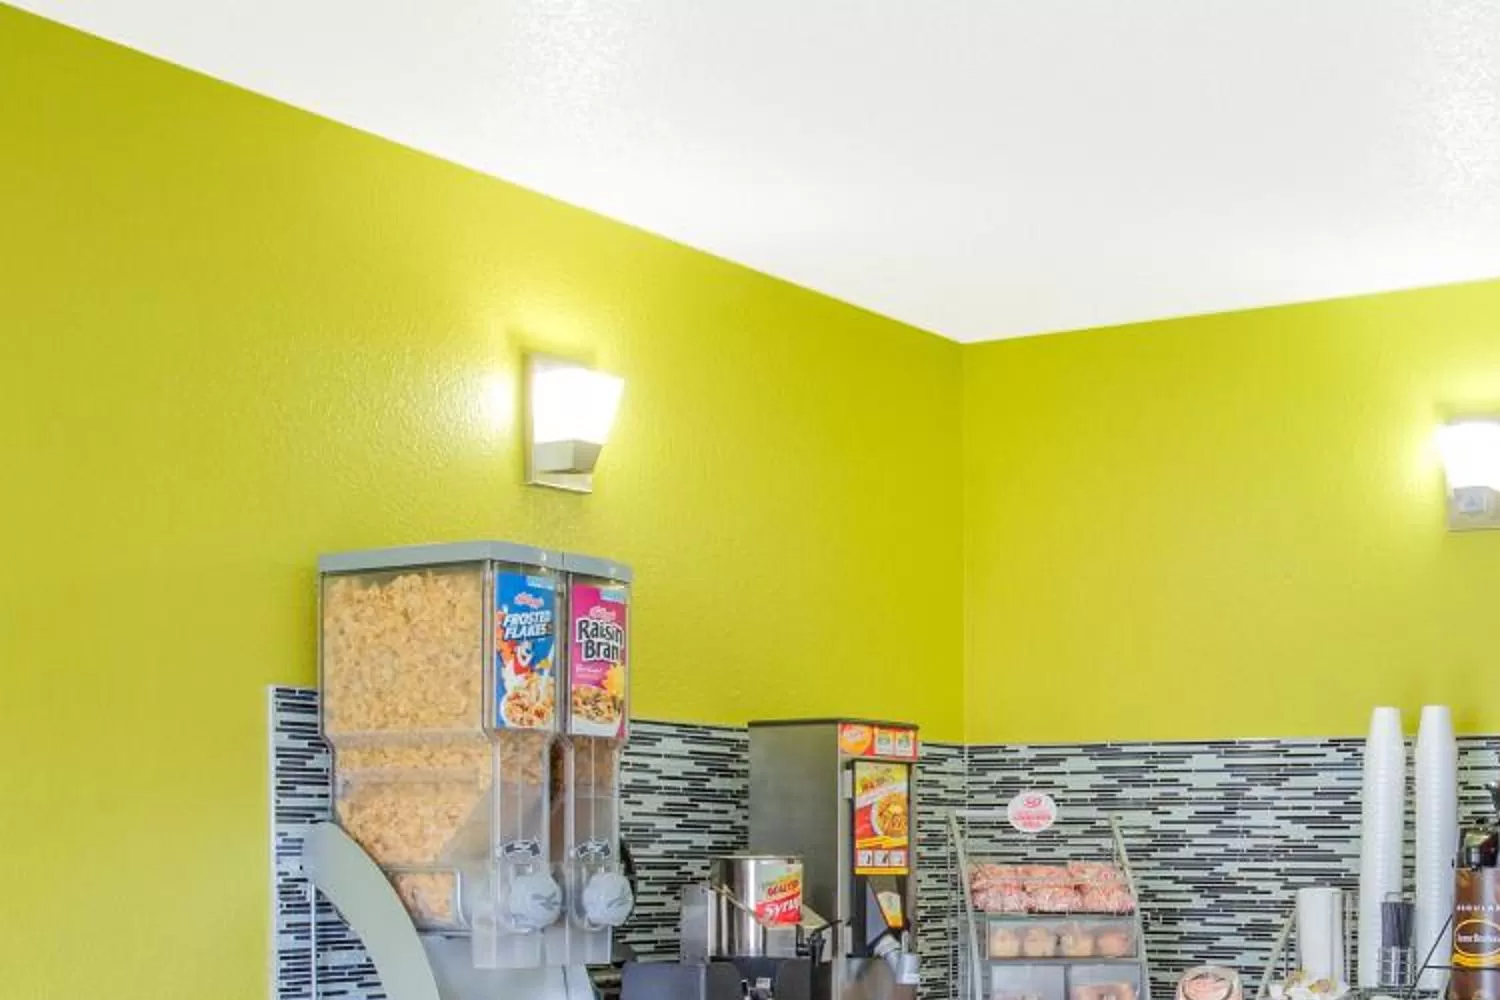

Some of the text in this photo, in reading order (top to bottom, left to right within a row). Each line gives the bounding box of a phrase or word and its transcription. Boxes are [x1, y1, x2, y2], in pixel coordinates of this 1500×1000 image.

[503, 610, 552, 628] FROSTED
[504, 624, 548, 641] FLAKES
[577, 618, 625, 643] Raisin
[584, 639, 620, 661] Bran
